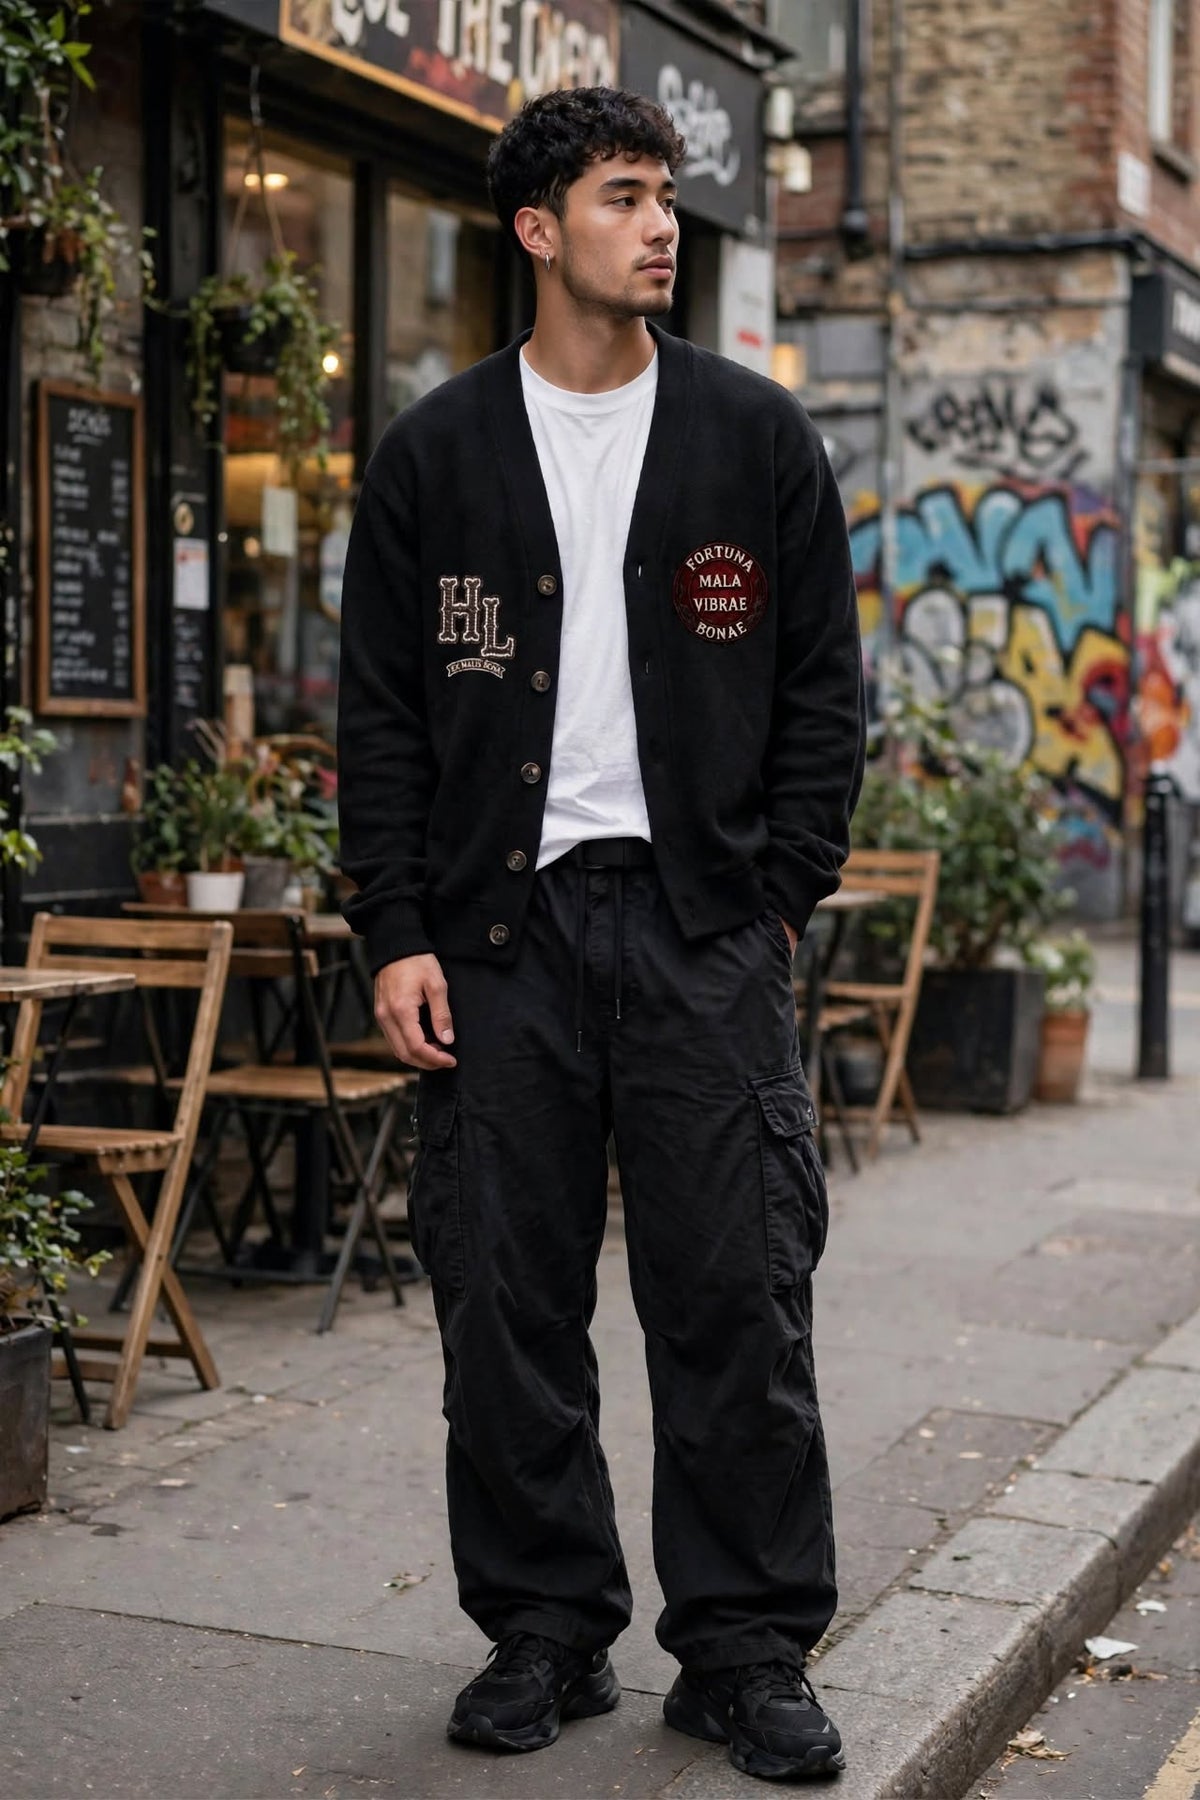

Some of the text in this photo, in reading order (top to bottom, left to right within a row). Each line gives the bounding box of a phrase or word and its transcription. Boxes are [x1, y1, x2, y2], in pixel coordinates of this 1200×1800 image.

[685, 545, 754, 573] FORTUNA
[699, 574, 741, 588] MALA
[693, 597, 747, 612] VIBRAE
[695, 621, 747, 640] BONAE
